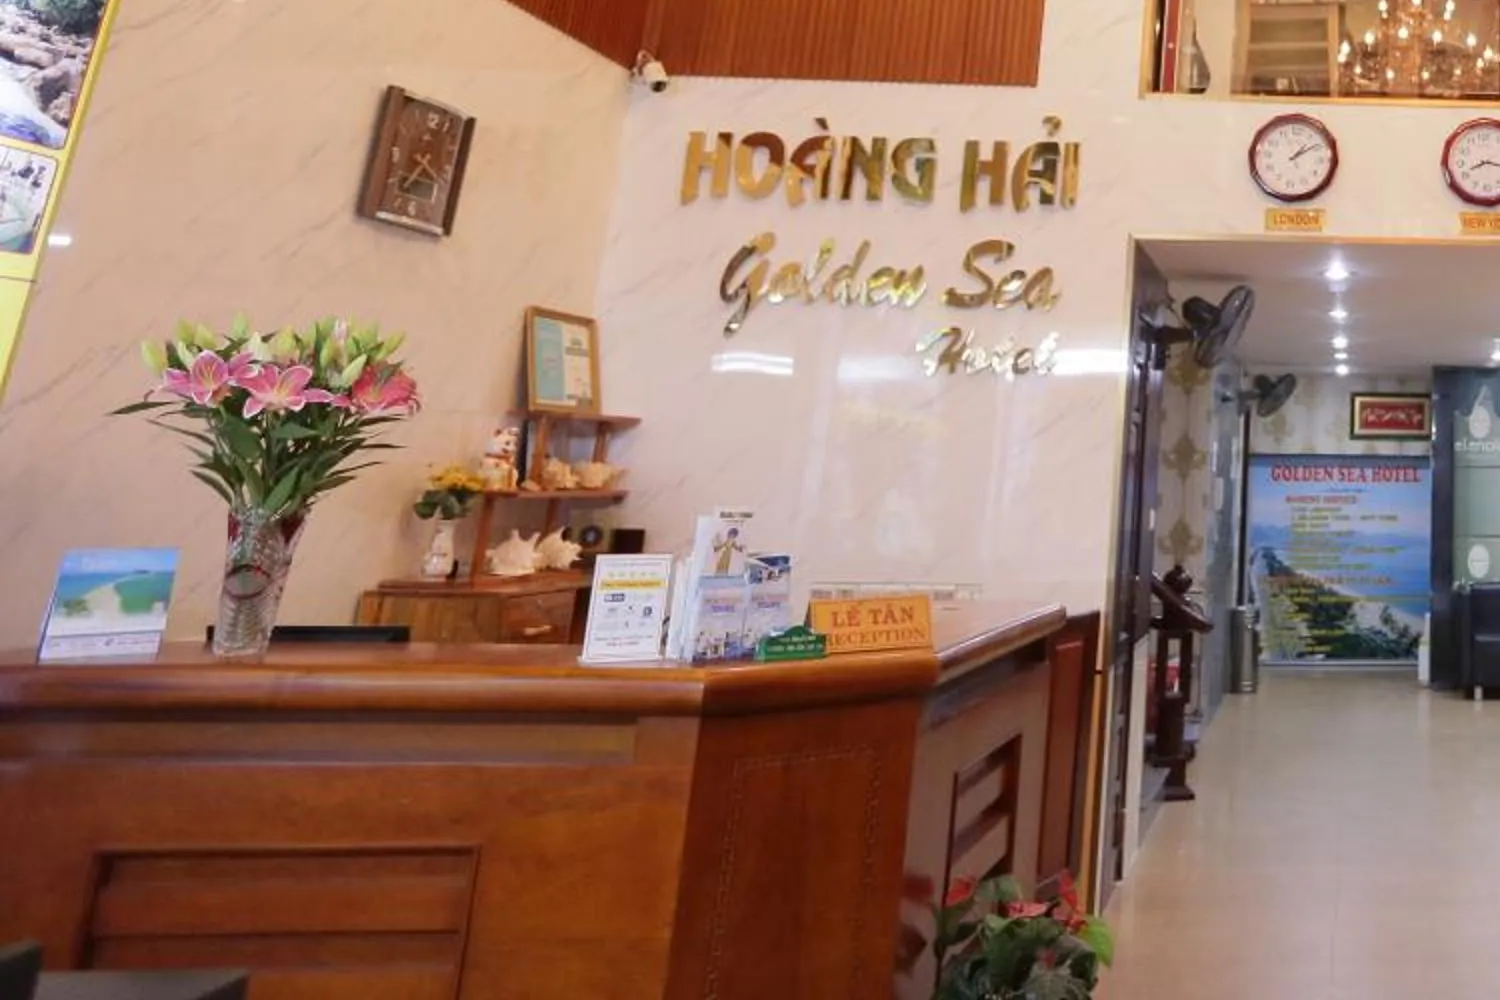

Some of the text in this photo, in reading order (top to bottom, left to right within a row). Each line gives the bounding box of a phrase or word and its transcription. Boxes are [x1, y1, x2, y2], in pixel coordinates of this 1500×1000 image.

[680, 115, 1080, 213] HOÀNG HẢI
[1273, 213, 1320, 225] LONDON
[719, 231, 1062, 337] Golden Sea
[1271, 465, 1422, 483] GOLDEN SEA HOTEL
